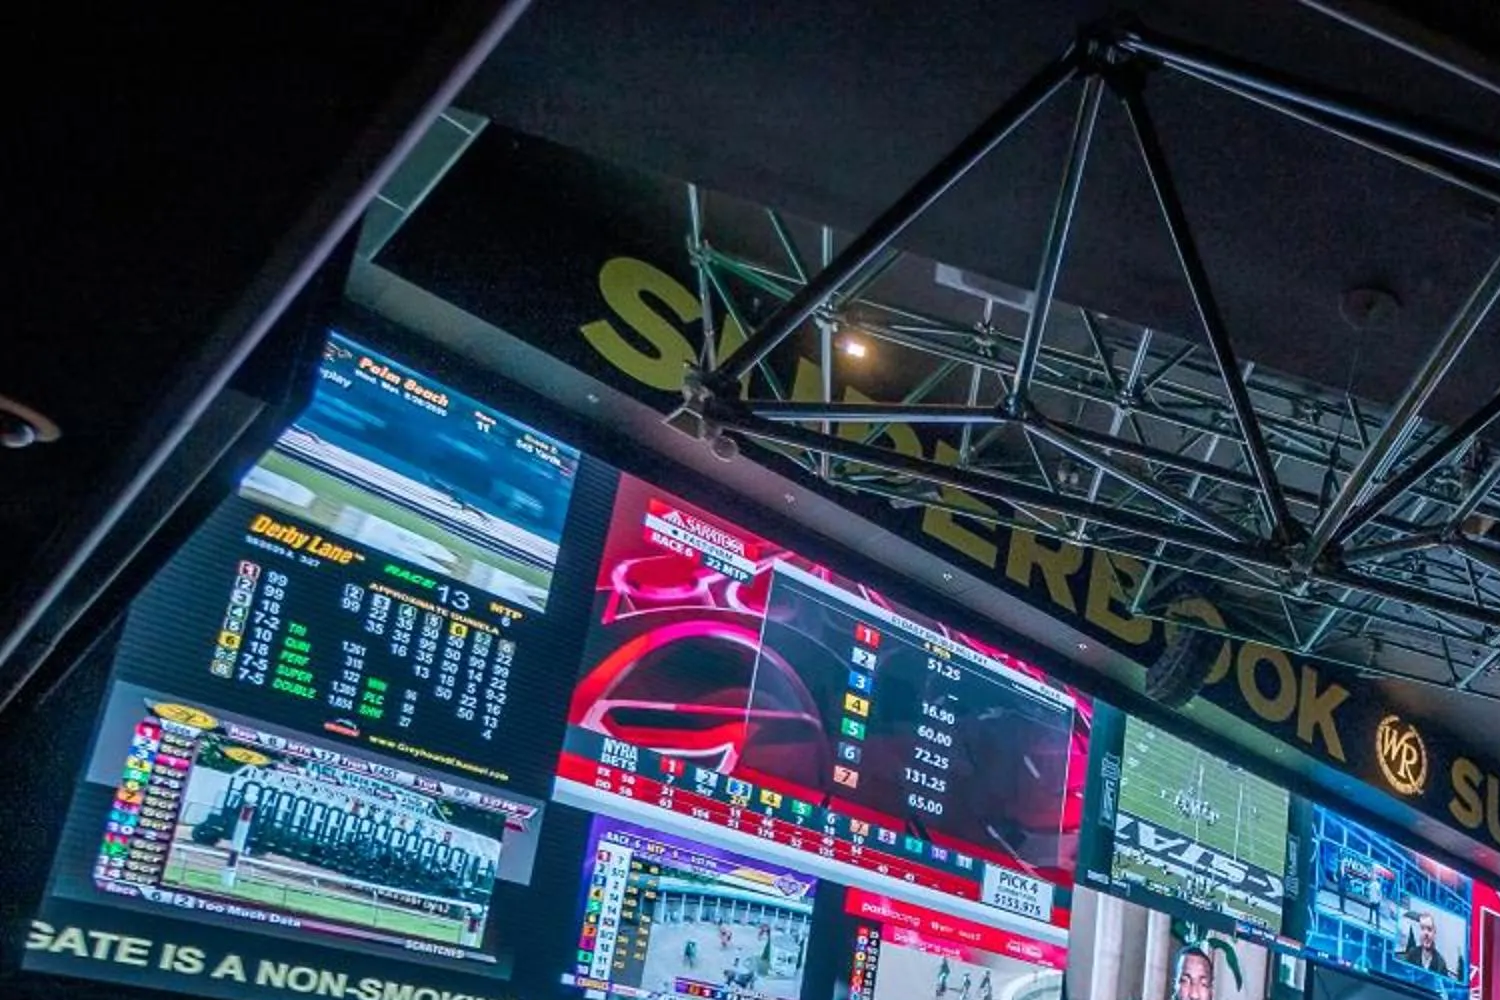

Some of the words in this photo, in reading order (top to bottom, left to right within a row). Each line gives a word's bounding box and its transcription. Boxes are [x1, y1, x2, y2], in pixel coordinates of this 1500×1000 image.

[358, 356, 400, 385] Palm
[403, 378, 449, 407] Beach
[251, 514, 309, 549] Derby
[310, 535, 353, 565] Lane
[651, 531, 684, 555] RACE
[687, 517, 745, 557] SARATOGA
[268, 571, 288, 587] 99
[706, 557, 721, 572] 22
[722, 562, 749, 580] MTP
[263, 585, 285, 600] 99
[384, 564, 437, 589] RACE
[437, 585, 470, 611] 13
[261, 600, 280, 615] 18
[489, 602, 523, 620] MTP
[254, 612, 281, 631] 7-2
[254, 627, 273, 642] 10
[250, 641, 269, 656] 18
[242, 653, 268, 672] 7-5
[414, 665, 430, 680] 13
[927, 658, 961, 682] 51.25
[238, 667, 265, 685] 7-5
[456, 706, 475, 721] 50
[483, 715, 498, 729] 13
[922, 703, 955, 726] 16.90
[917, 724, 952, 747] 60.00
[602, 738, 639, 762] NYRA
[914, 747, 949, 770] 72.25
[600, 752, 637, 773] BETS
[905, 768, 946, 792] 131.25
[908, 792, 943, 816] 65.00
[1000, 871, 1030, 893] PICK
[1031, 882, 1039, 895] 4
[195, 899, 224, 914] Too
[227, 904, 266, 922] Much
[268, 911, 301, 929] Data
[158, 943, 206, 975] IS
[209, 954, 248, 983] A
